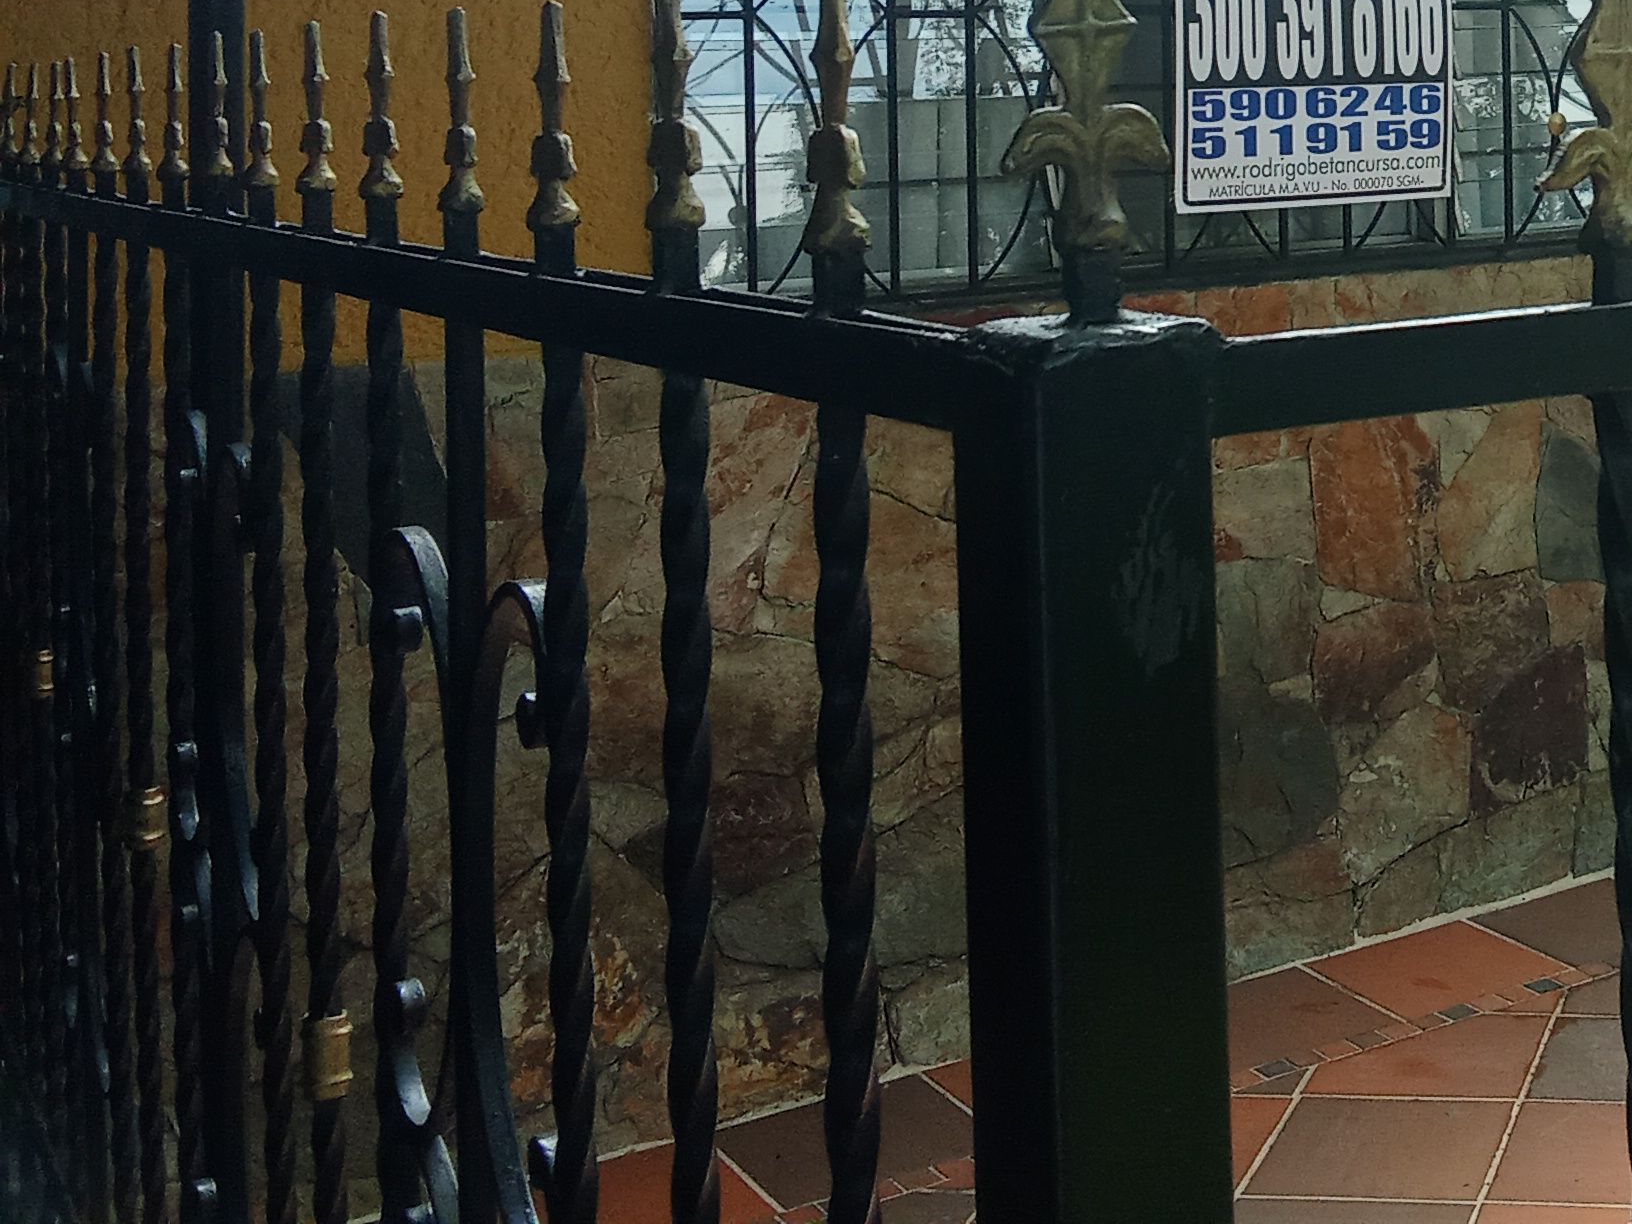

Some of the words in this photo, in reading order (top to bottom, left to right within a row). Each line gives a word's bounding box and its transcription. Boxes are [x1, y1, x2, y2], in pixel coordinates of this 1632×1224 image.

[1191, 154, 1441, 181] www.rodrigobetancursa.com
[1209, 181, 1275, 198] MATRÍCULA
[1331, 179, 1350, 191] No.
[1353, 176, 1394, 190] 000070
